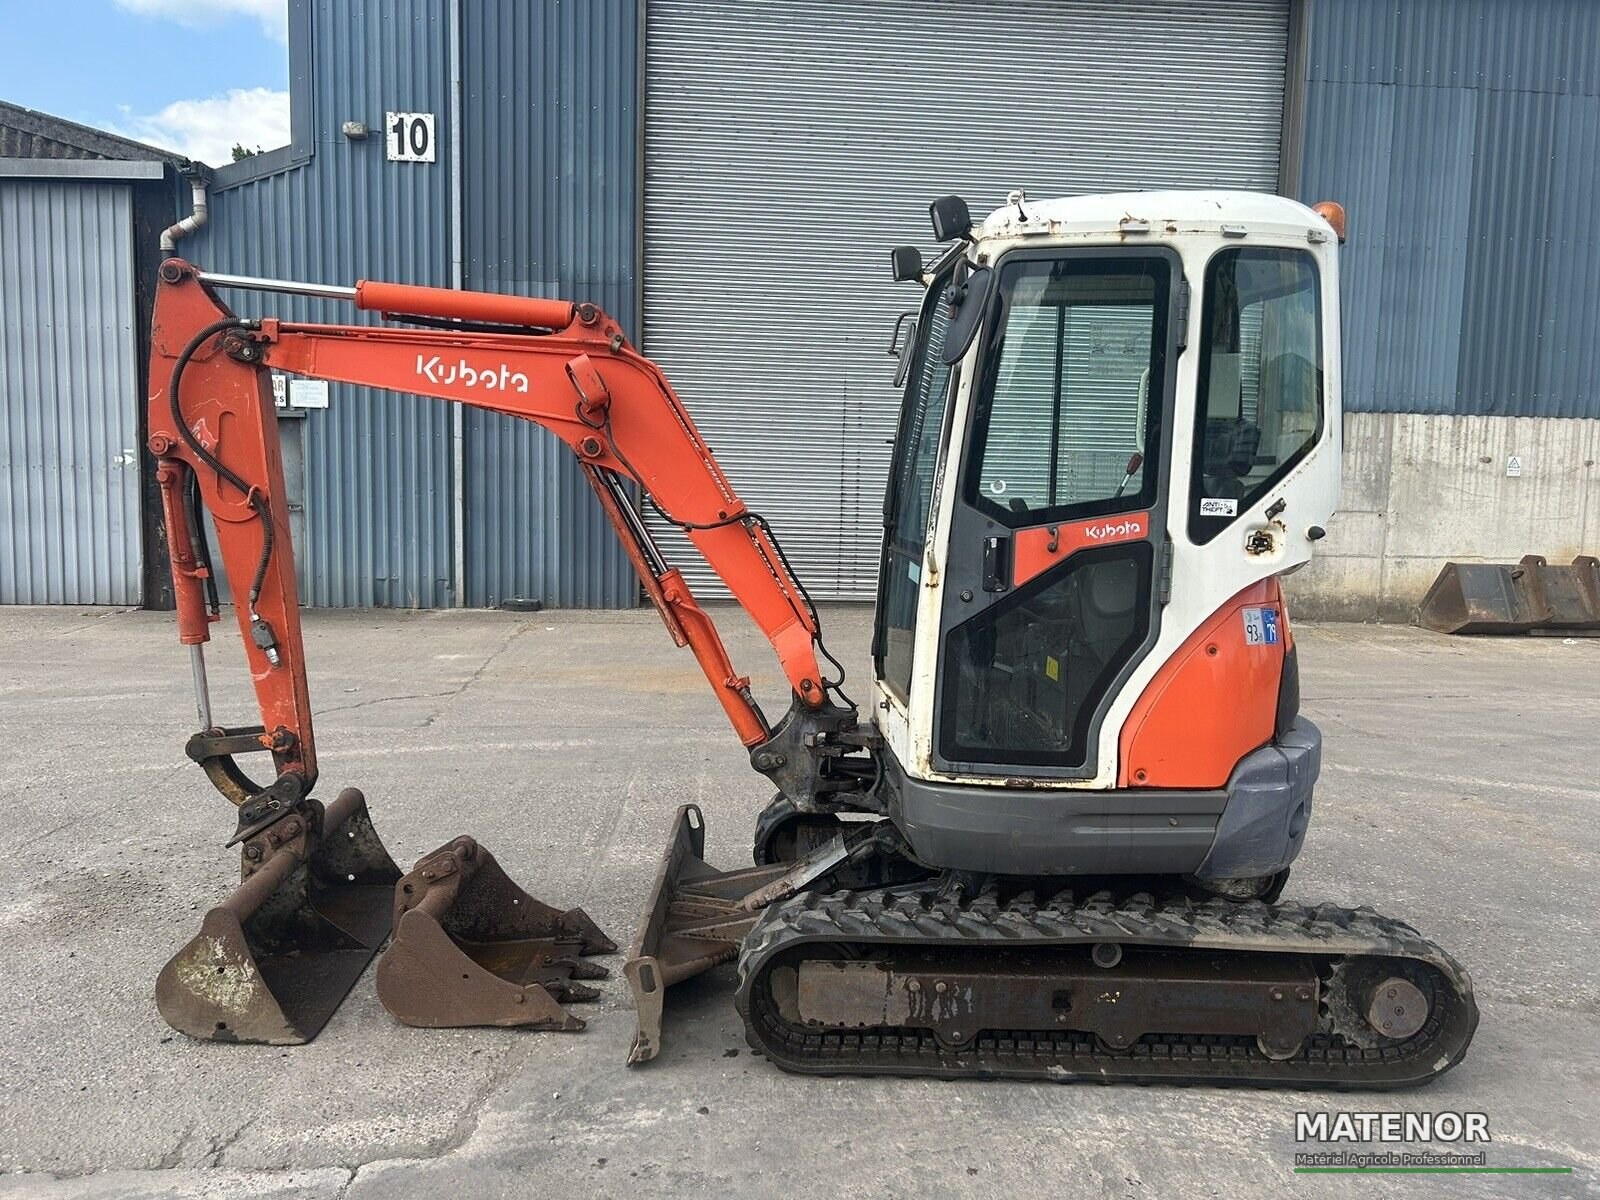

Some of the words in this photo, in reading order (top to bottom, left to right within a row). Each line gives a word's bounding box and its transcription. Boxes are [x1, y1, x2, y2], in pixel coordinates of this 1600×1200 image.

[392, 117, 428, 156] 10
[416, 354, 528, 393] Kubota
[1085, 521, 1140, 539] Kubota
[1246, 624, 1259, 642] 93
